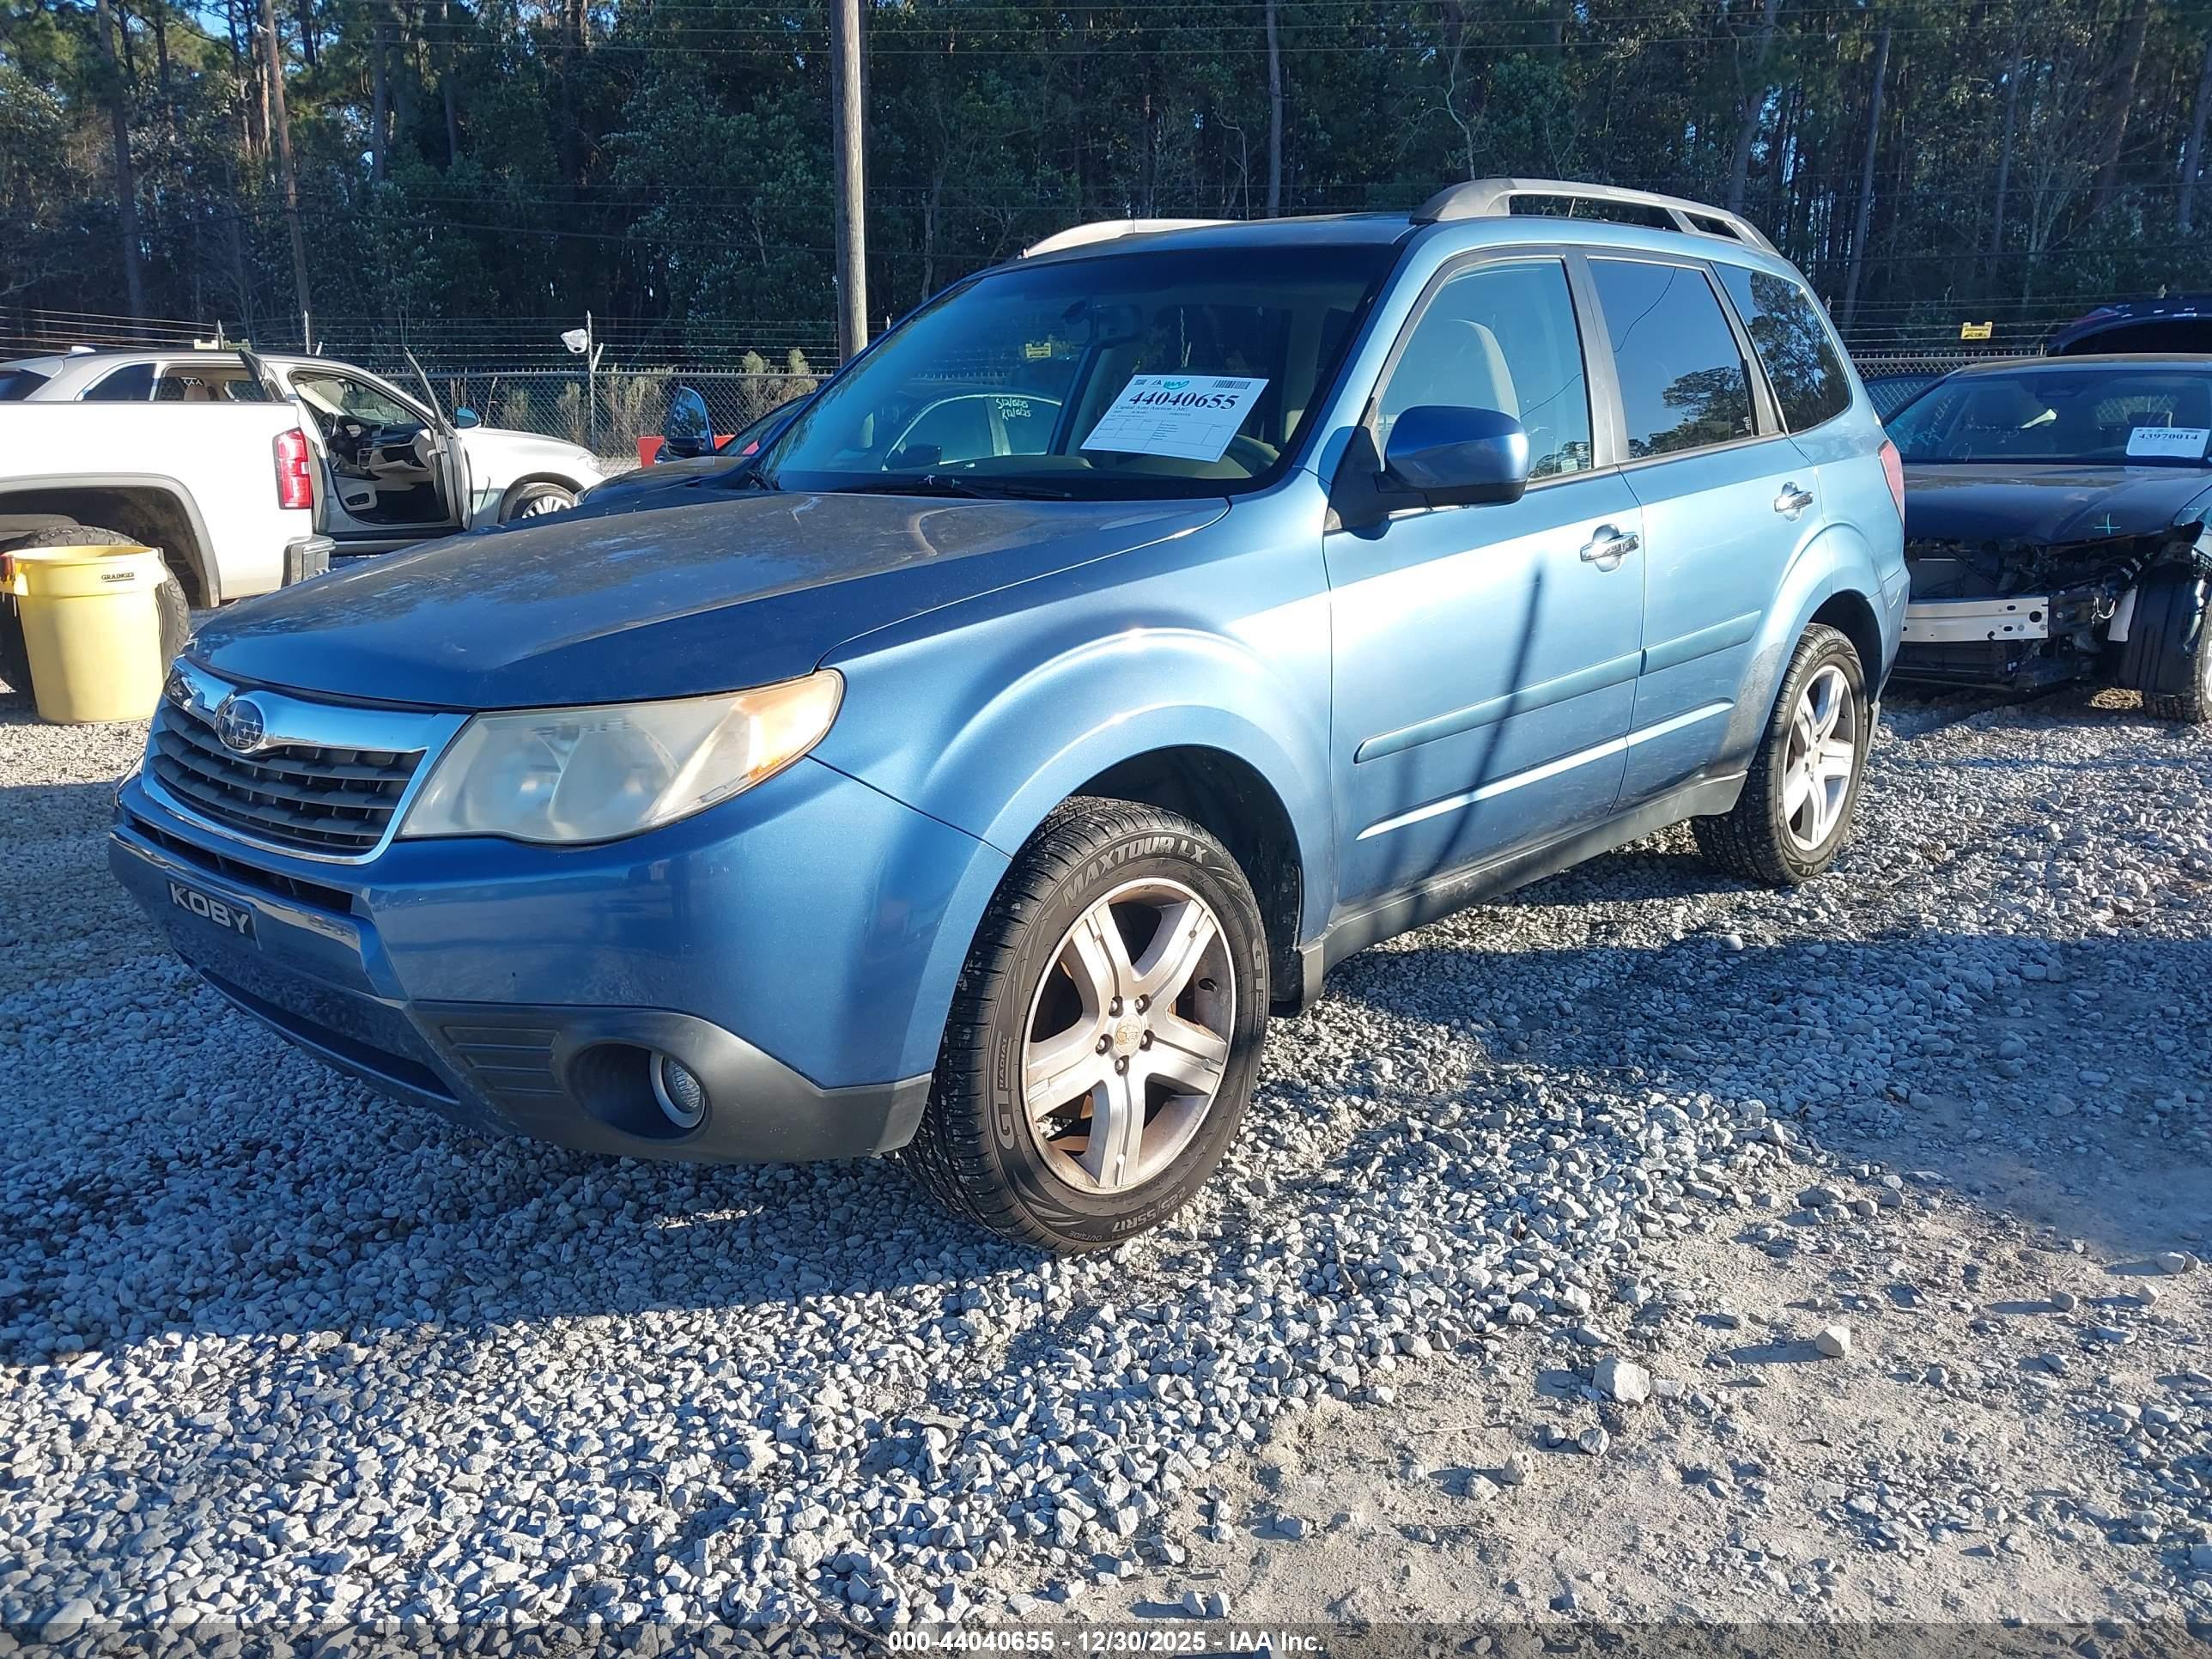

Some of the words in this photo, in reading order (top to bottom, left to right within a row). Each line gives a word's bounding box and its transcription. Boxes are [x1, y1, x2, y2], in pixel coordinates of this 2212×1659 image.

[1128, 391, 1241, 410] 44040655
[1061, 836, 1175, 908] MAXTOUR
[1178, 839, 1208, 864] LX
[170, 883, 249, 934] KOBY
[999, 1036, 1008, 1088] RADIAL
[1112, 1186, 1187, 1233] 225/55R17
[1068, 1231, 1103, 1243] OUTSIDE
